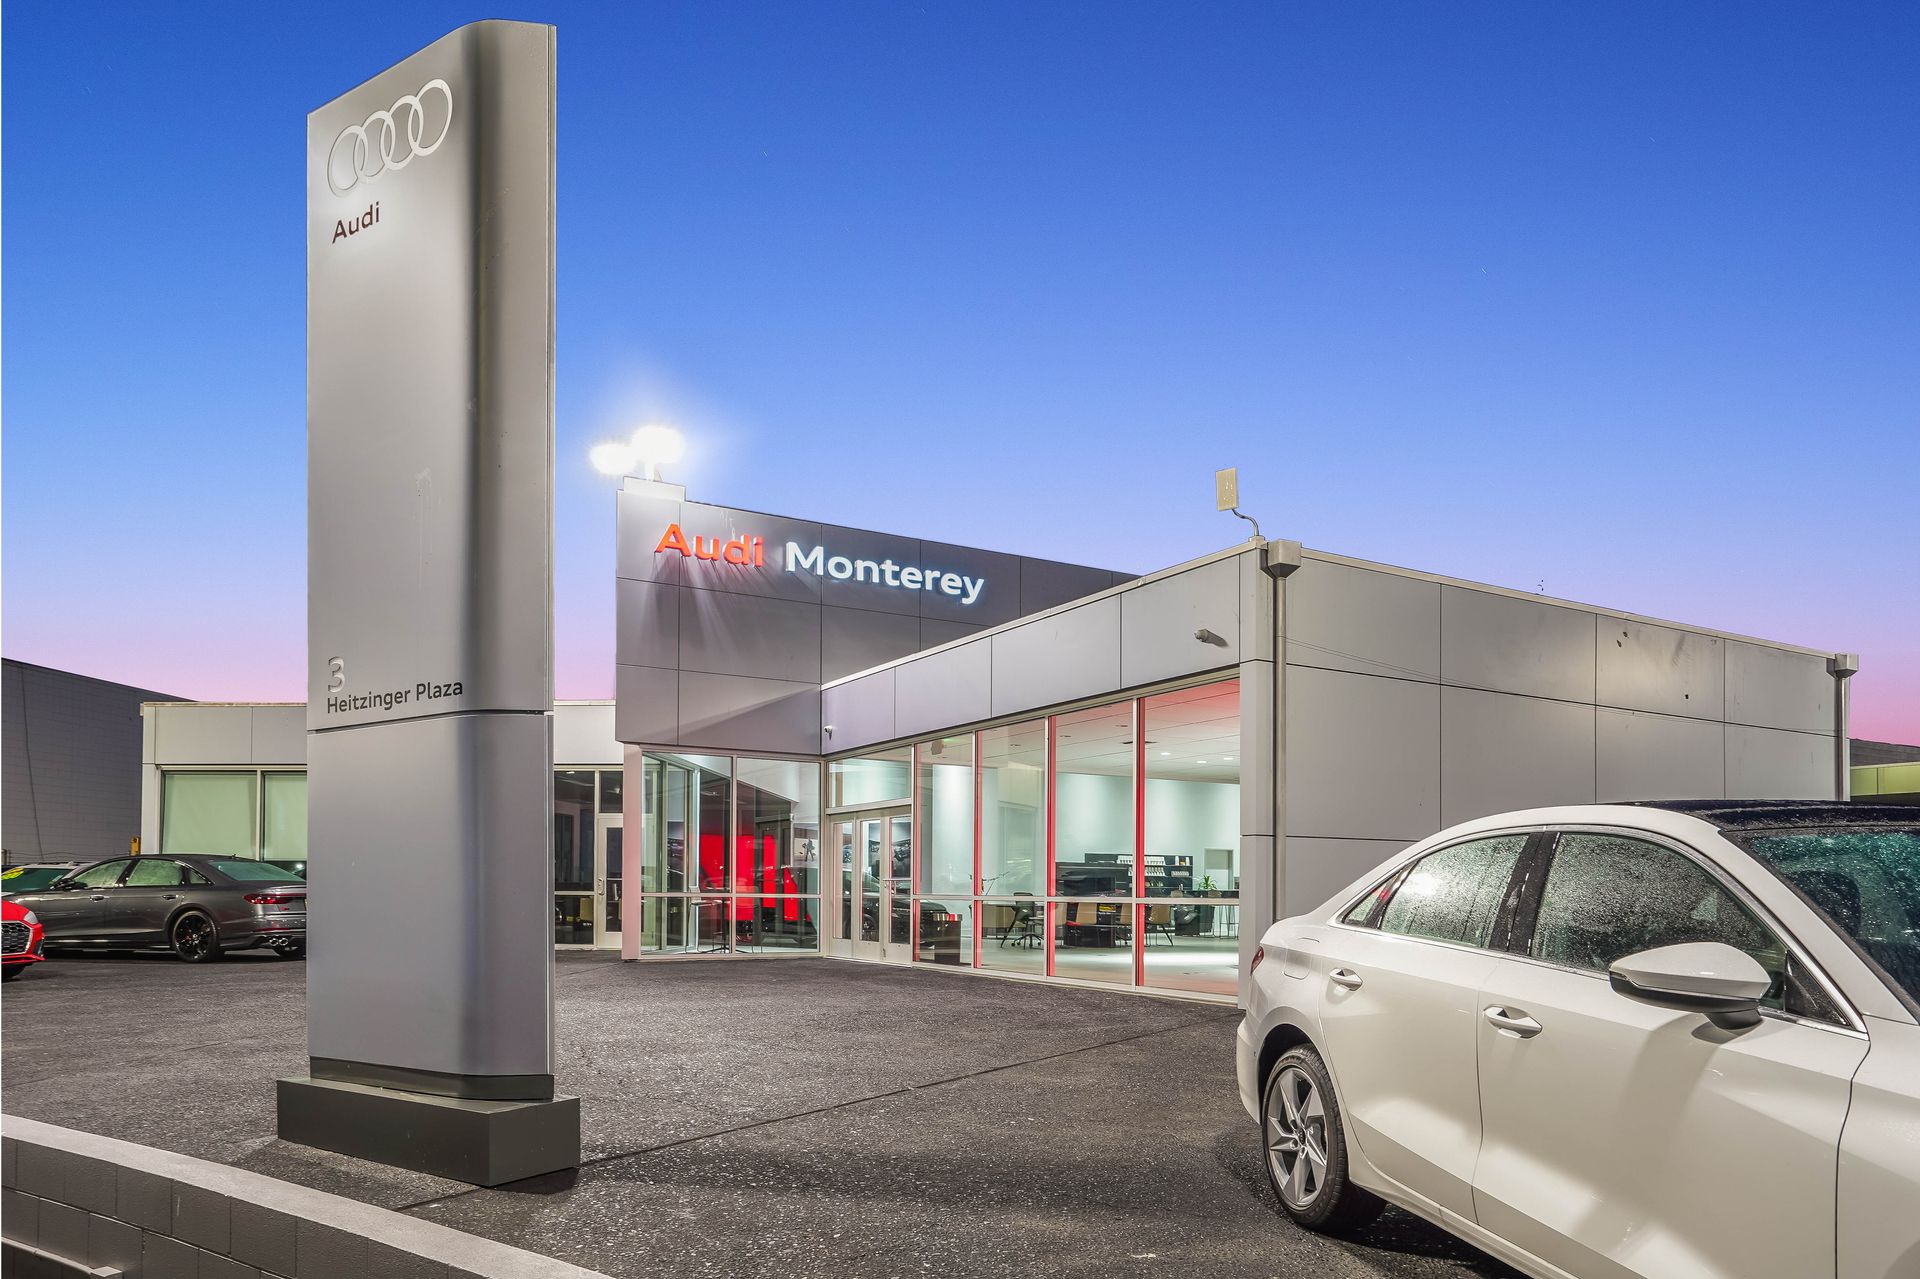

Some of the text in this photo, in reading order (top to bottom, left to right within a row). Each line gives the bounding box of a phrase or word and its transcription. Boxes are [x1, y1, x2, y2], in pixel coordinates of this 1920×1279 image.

[332, 201, 380, 244] Audi
[654, 523, 985, 605] Audi Monterey
[327, 656, 346, 693] 3
[327, 681, 463, 714] Heitzinger Plaza
